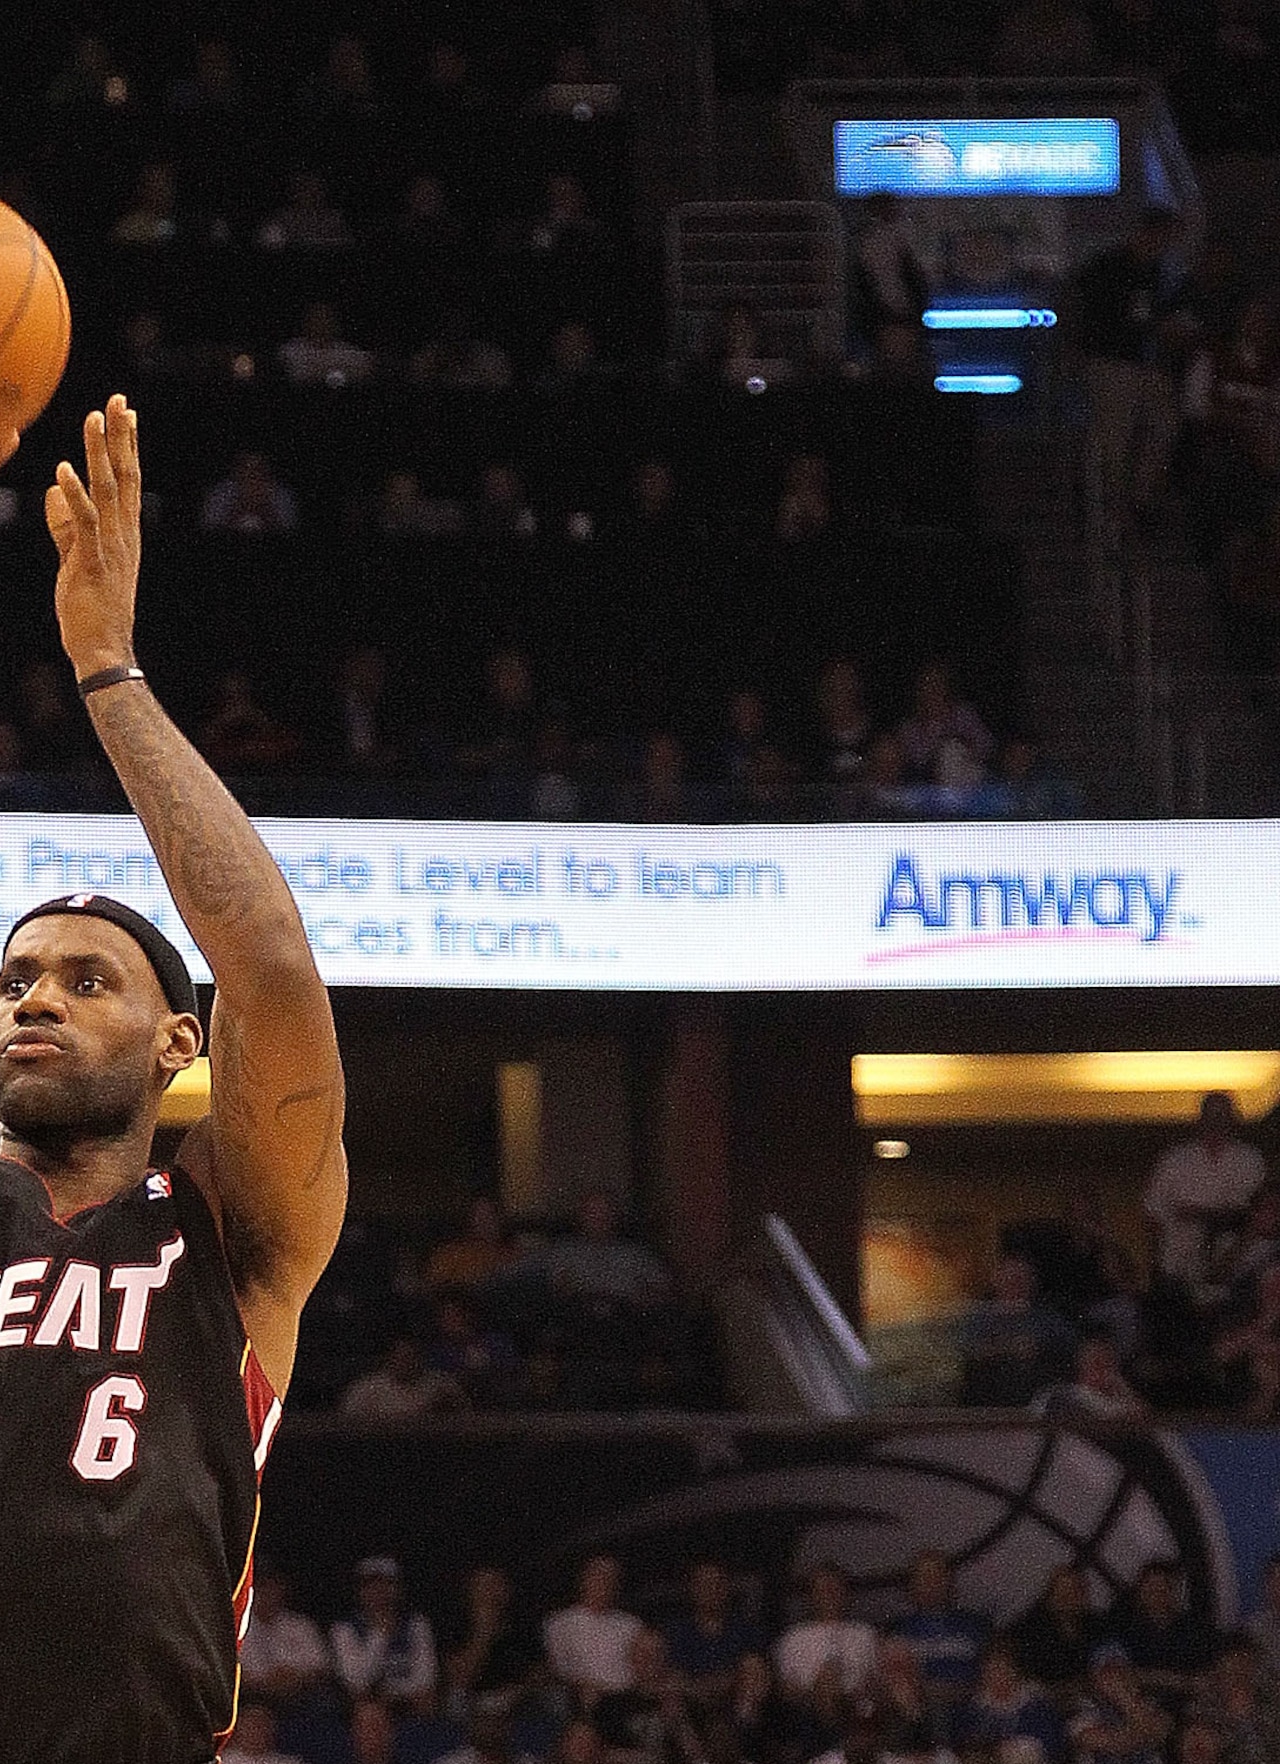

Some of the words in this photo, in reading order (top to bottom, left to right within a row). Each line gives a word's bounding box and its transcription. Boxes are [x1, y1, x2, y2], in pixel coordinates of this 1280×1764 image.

[394, 846, 542, 897] Level
[560, 847, 618, 897] to
[633, 848, 787, 899] learn
[873, 853, 1182, 943] Amway
[70, 1371, 148, 1482] 6
